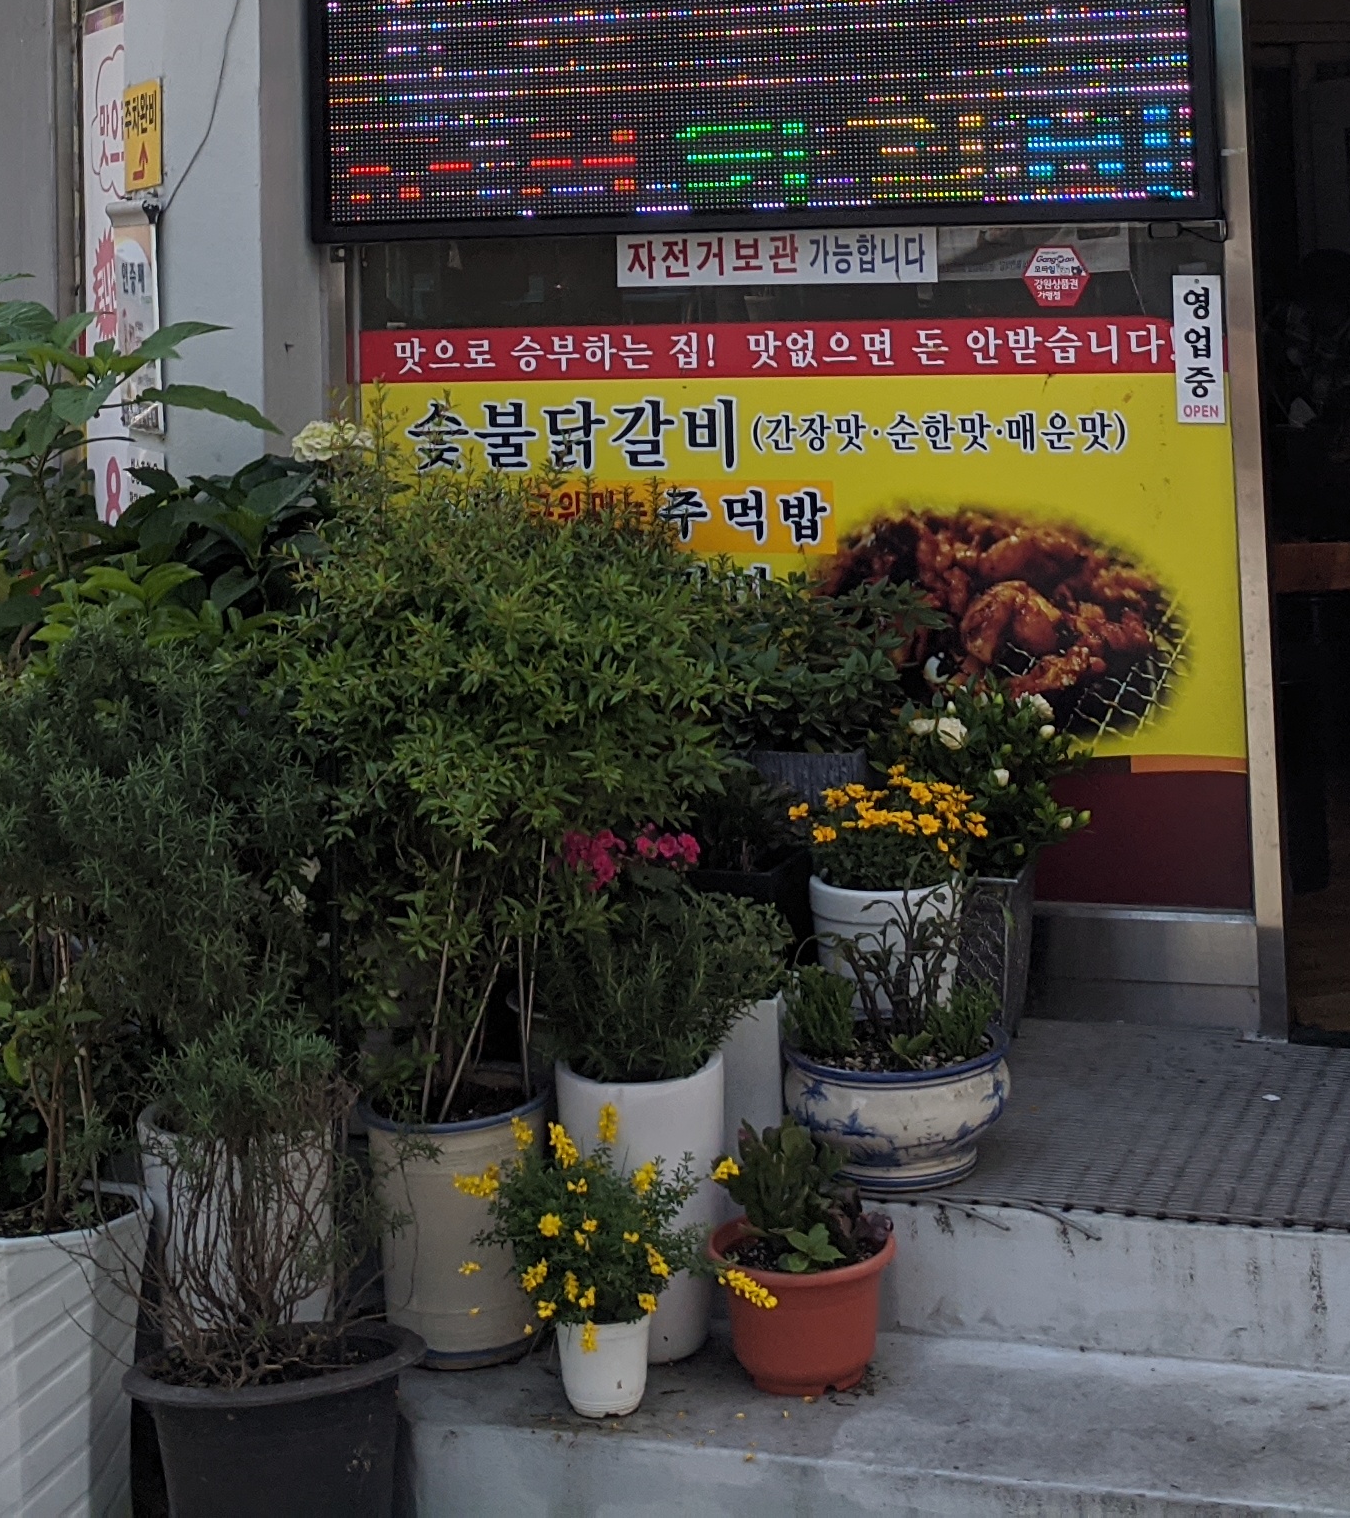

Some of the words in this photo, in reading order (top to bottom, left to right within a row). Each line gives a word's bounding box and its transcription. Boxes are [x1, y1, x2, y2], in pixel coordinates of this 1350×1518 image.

[124, 90, 157, 140] 주차완비
[626, 232, 799, 279] 자전거보관
[809, 230, 927, 281] 가능합니다
[1034, 278, 1079, 290] 강원상품권
[394, 336, 496, 374] 맛으로
[509, 332, 654, 372] 승부하는
[669, 331, 716, 370] 집!
[747, 328, 897, 370] 맛없으면
[910, 328, 948, 367] 돈
[1182, 286, 1216, 399] 영업중
[405, 395, 739, 472] 숯불닭갈비
[1183, 404, 1219, 418] OPEN
[658, 486, 832, 546] 주먹밥
